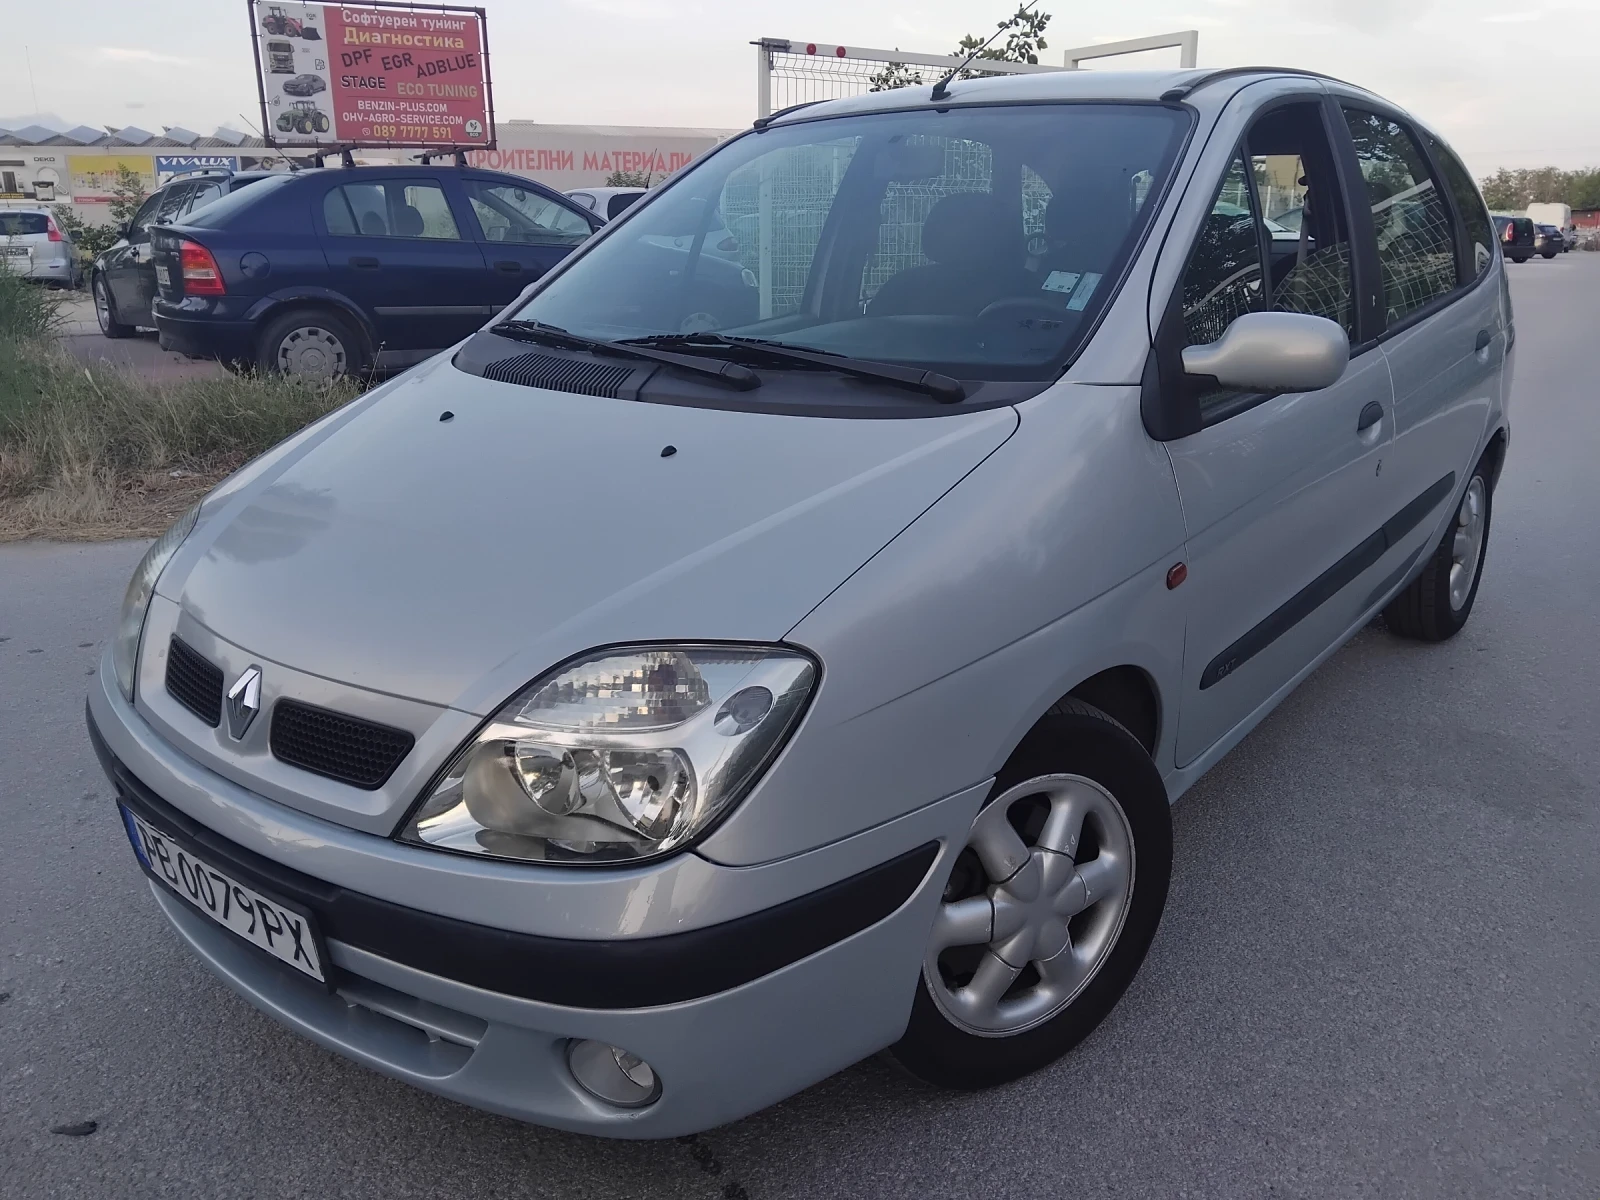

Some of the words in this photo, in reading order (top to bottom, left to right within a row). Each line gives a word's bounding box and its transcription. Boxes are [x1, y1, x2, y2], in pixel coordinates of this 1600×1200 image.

[342, 10, 417, 28] Софтуерен
[421, 18, 466, 31] тунинг
[344, 27, 465, 49] Диагностика
[341, 49, 373, 67] DPF
[381, 53, 414, 71] EGR
[416, 53, 476, 78] ADBLUE
[341, 75, 386, 89] STAGE
[397, 83, 424, 96] ECO
[427, 83, 478, 98] TUNING
[357, 100, 448, 113] BENZIN-PLUS.COM
[342, 112, 463, 125] OHV-AGRO-SERVICE.COM
[373, 125, 396, 138] 089
[400, 126, 428, 138] 7777
[432, 126, 452, 139] 591
[159, 157, 231, 166] VIVALUX
[453, 149, 574, 171] ТРОИТЕЛНИ
[583, 151, 692, 172] МАТЕРИАЛИ
